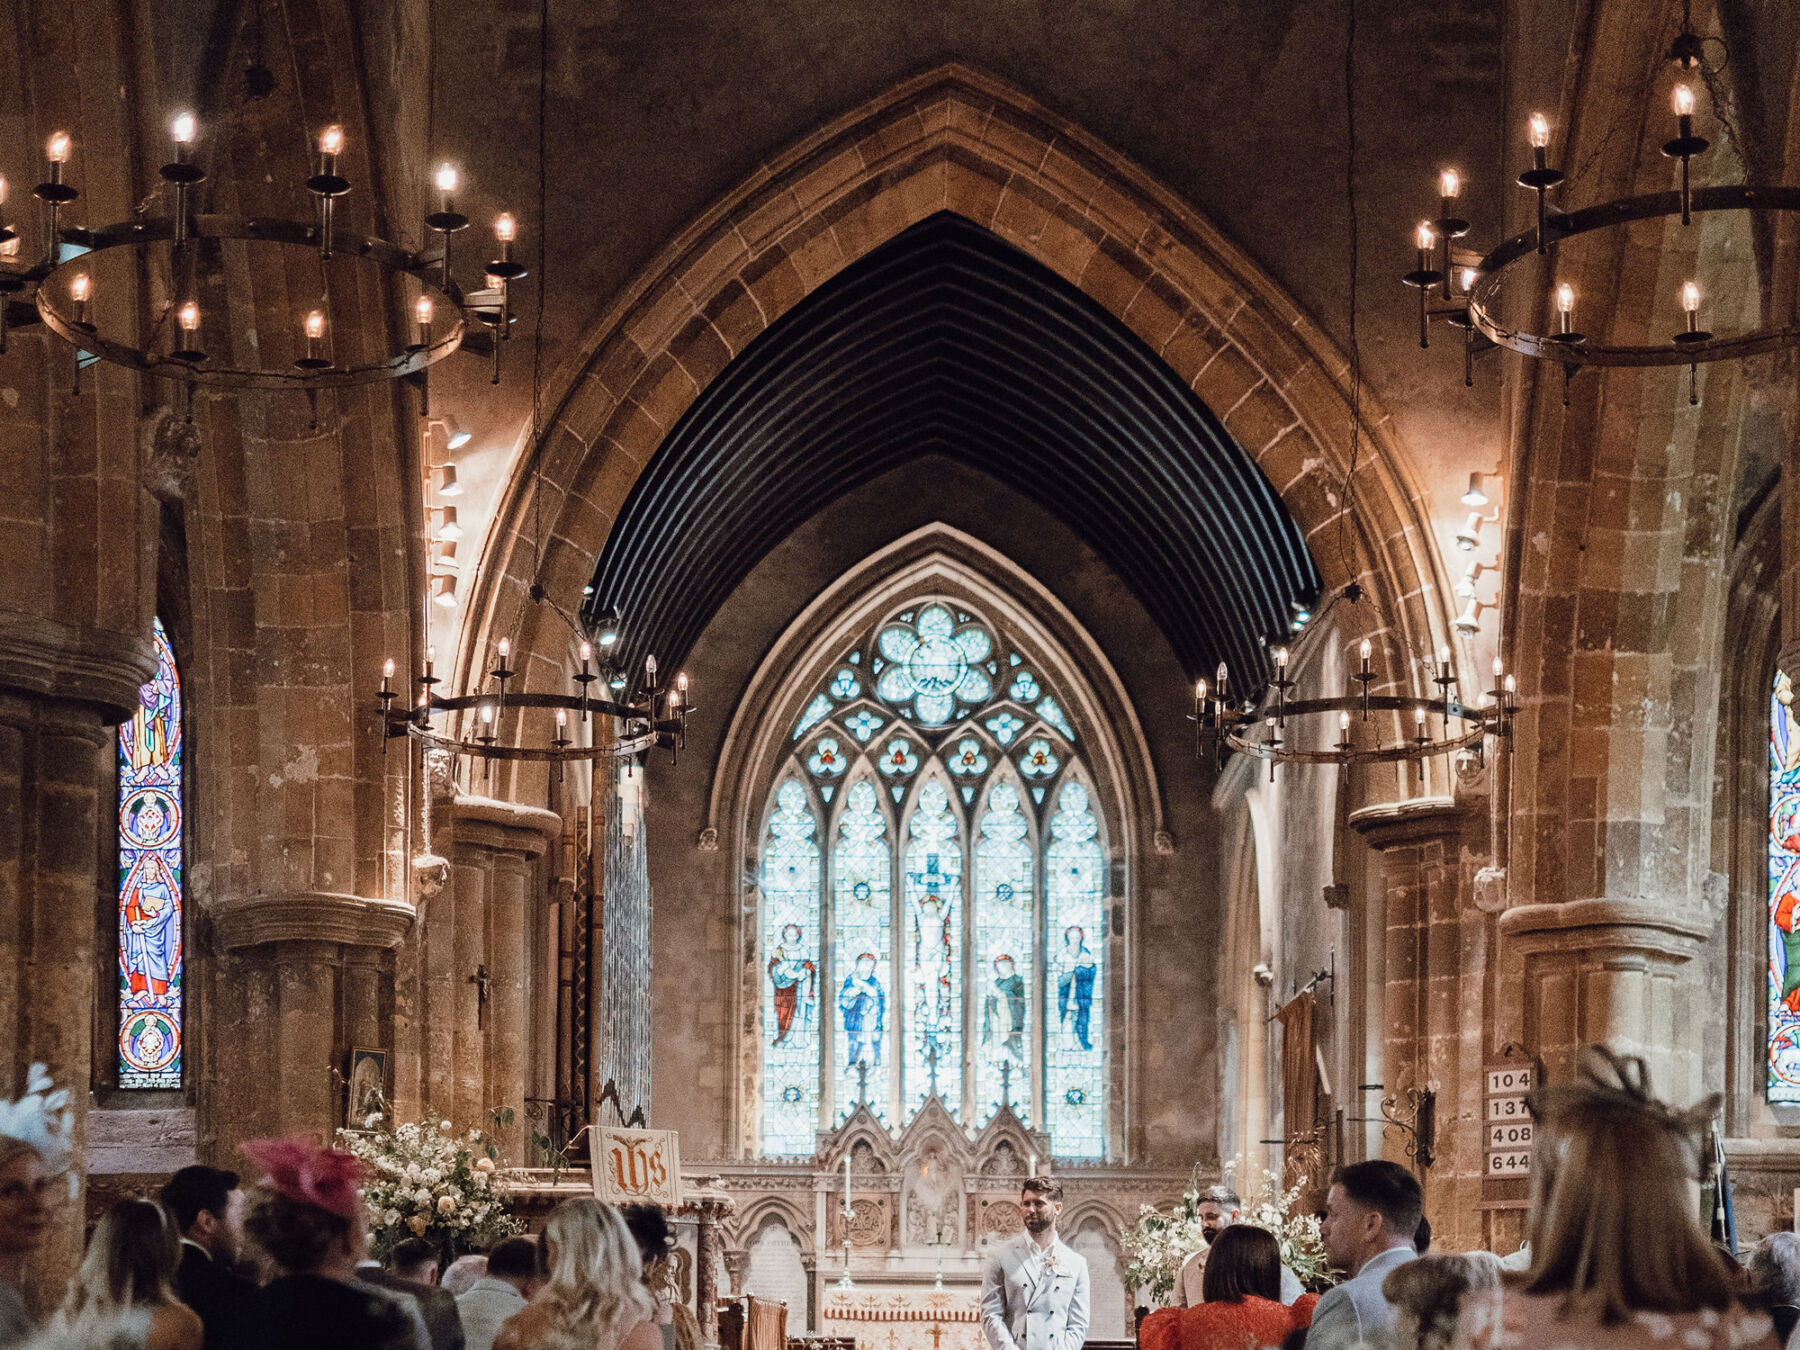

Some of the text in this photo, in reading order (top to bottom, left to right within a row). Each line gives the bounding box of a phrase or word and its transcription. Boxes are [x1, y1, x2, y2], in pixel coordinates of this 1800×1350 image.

[1492, 1073, 1530, 1089] 104
[1493, 1101, 1528, 1116] 137
[1492, 1128, 1531, 1143] 408
[1492, 1155, 1530, 1169] 644
